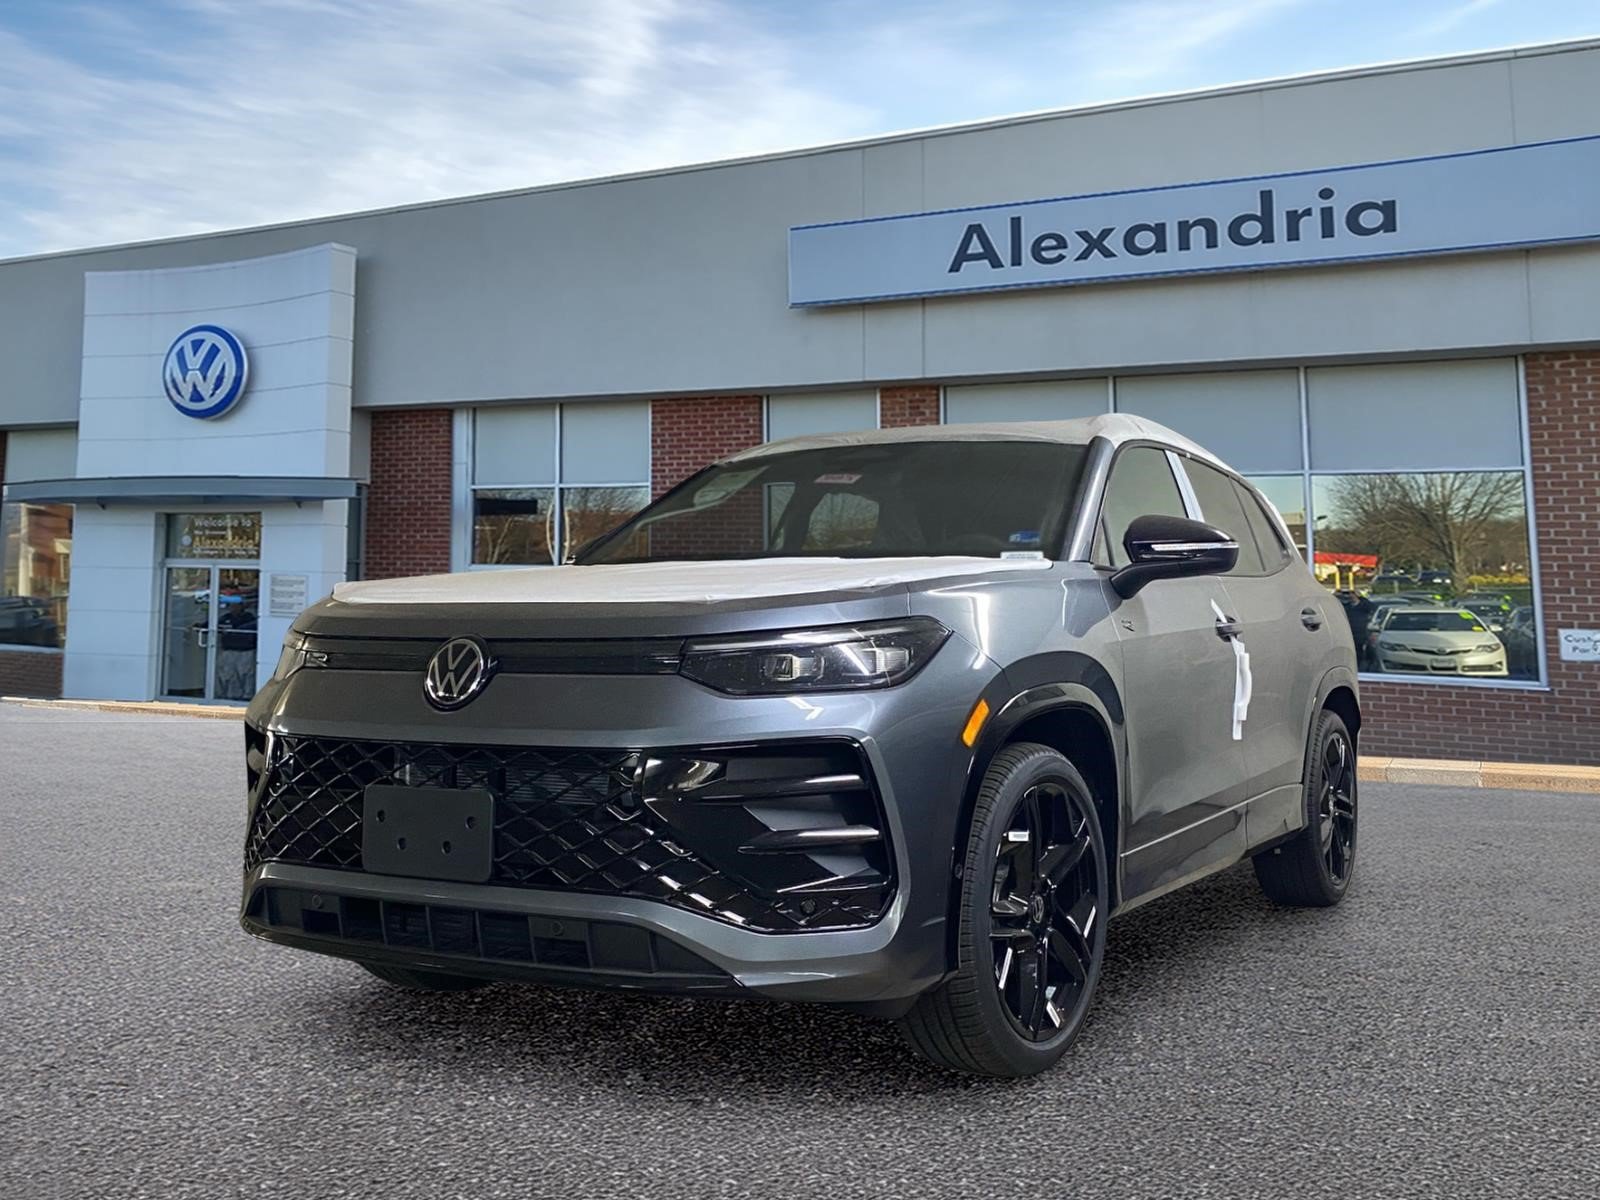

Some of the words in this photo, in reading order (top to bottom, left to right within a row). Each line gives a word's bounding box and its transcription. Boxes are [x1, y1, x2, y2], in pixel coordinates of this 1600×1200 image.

[947, 187, 1398, 274] Alexandria
[165, 329, 240, 410] VW
[428, 639, 483, 702] VW
